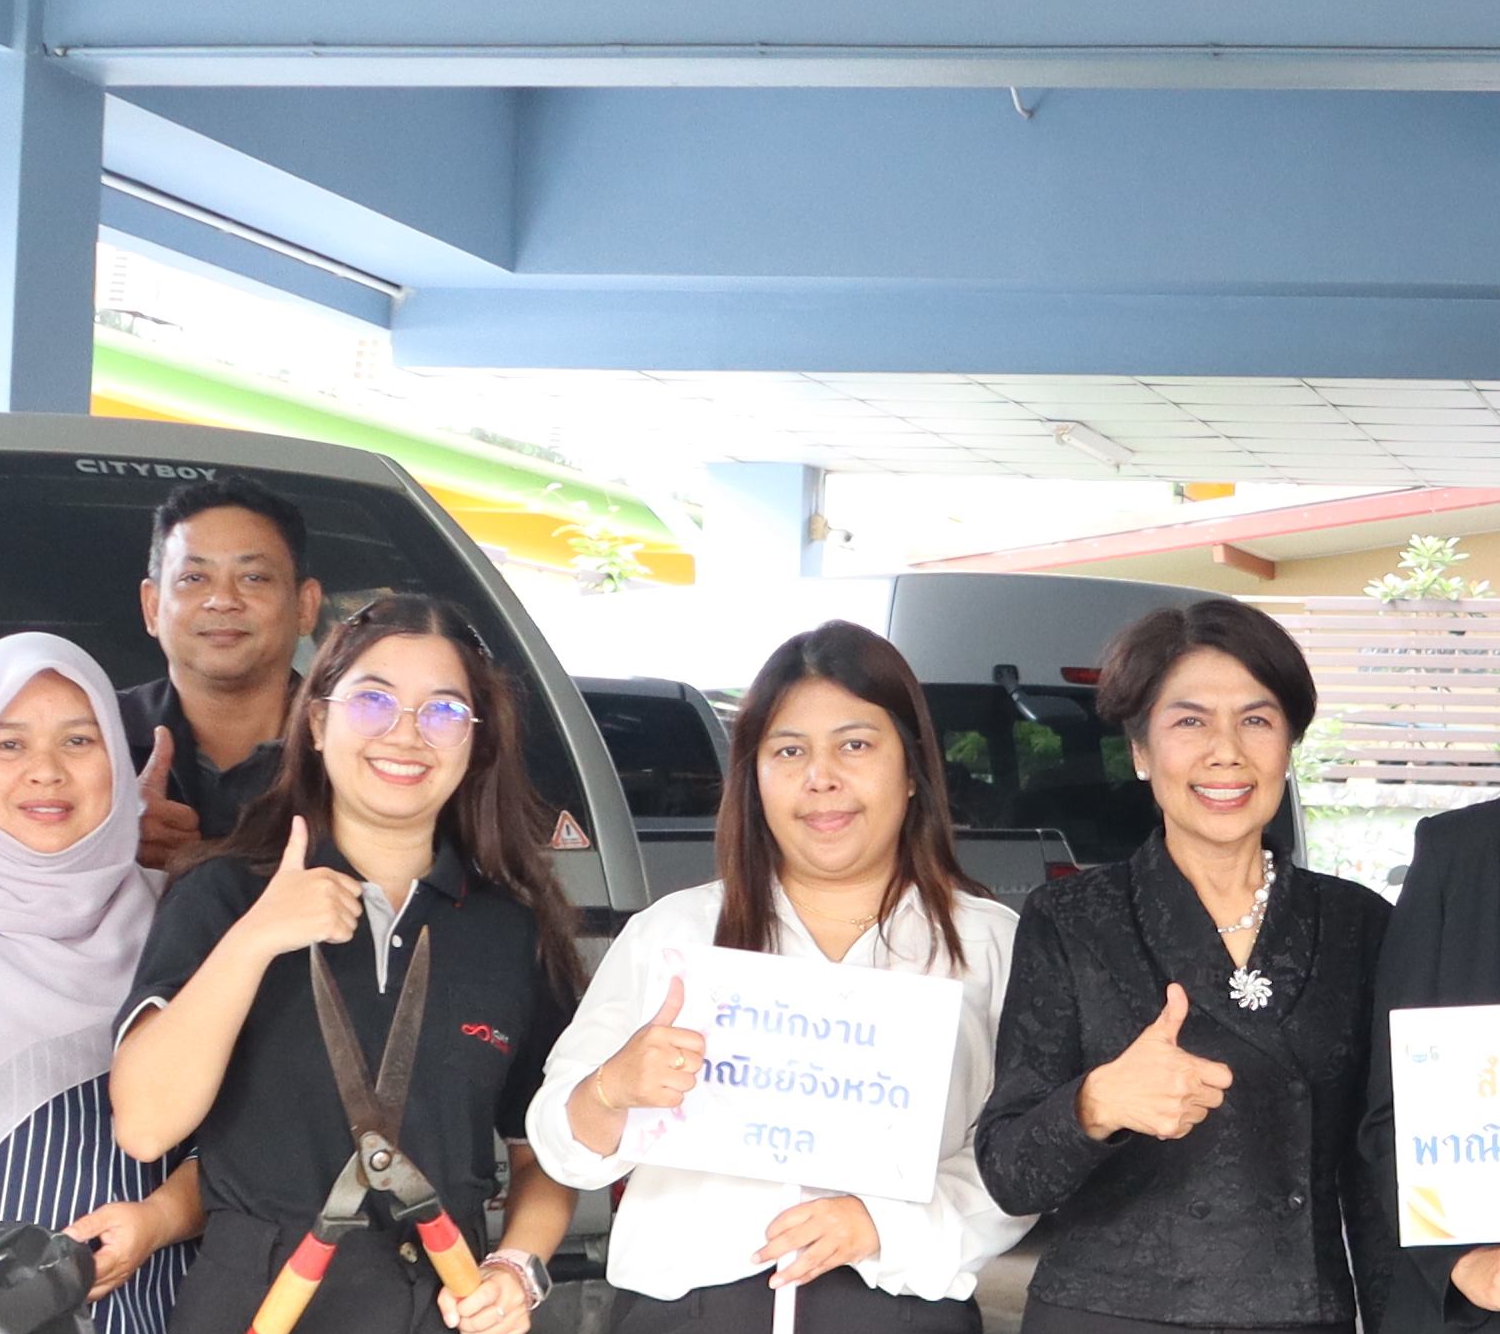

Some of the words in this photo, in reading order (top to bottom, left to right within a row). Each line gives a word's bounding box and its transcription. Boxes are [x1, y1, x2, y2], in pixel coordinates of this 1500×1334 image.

[714, 992, 877, 1048] สำนักงาน
[702, 1053, 911, 1110] าณิชย์จังหวัด
[742, 1121, 817, 1165] สตูล
